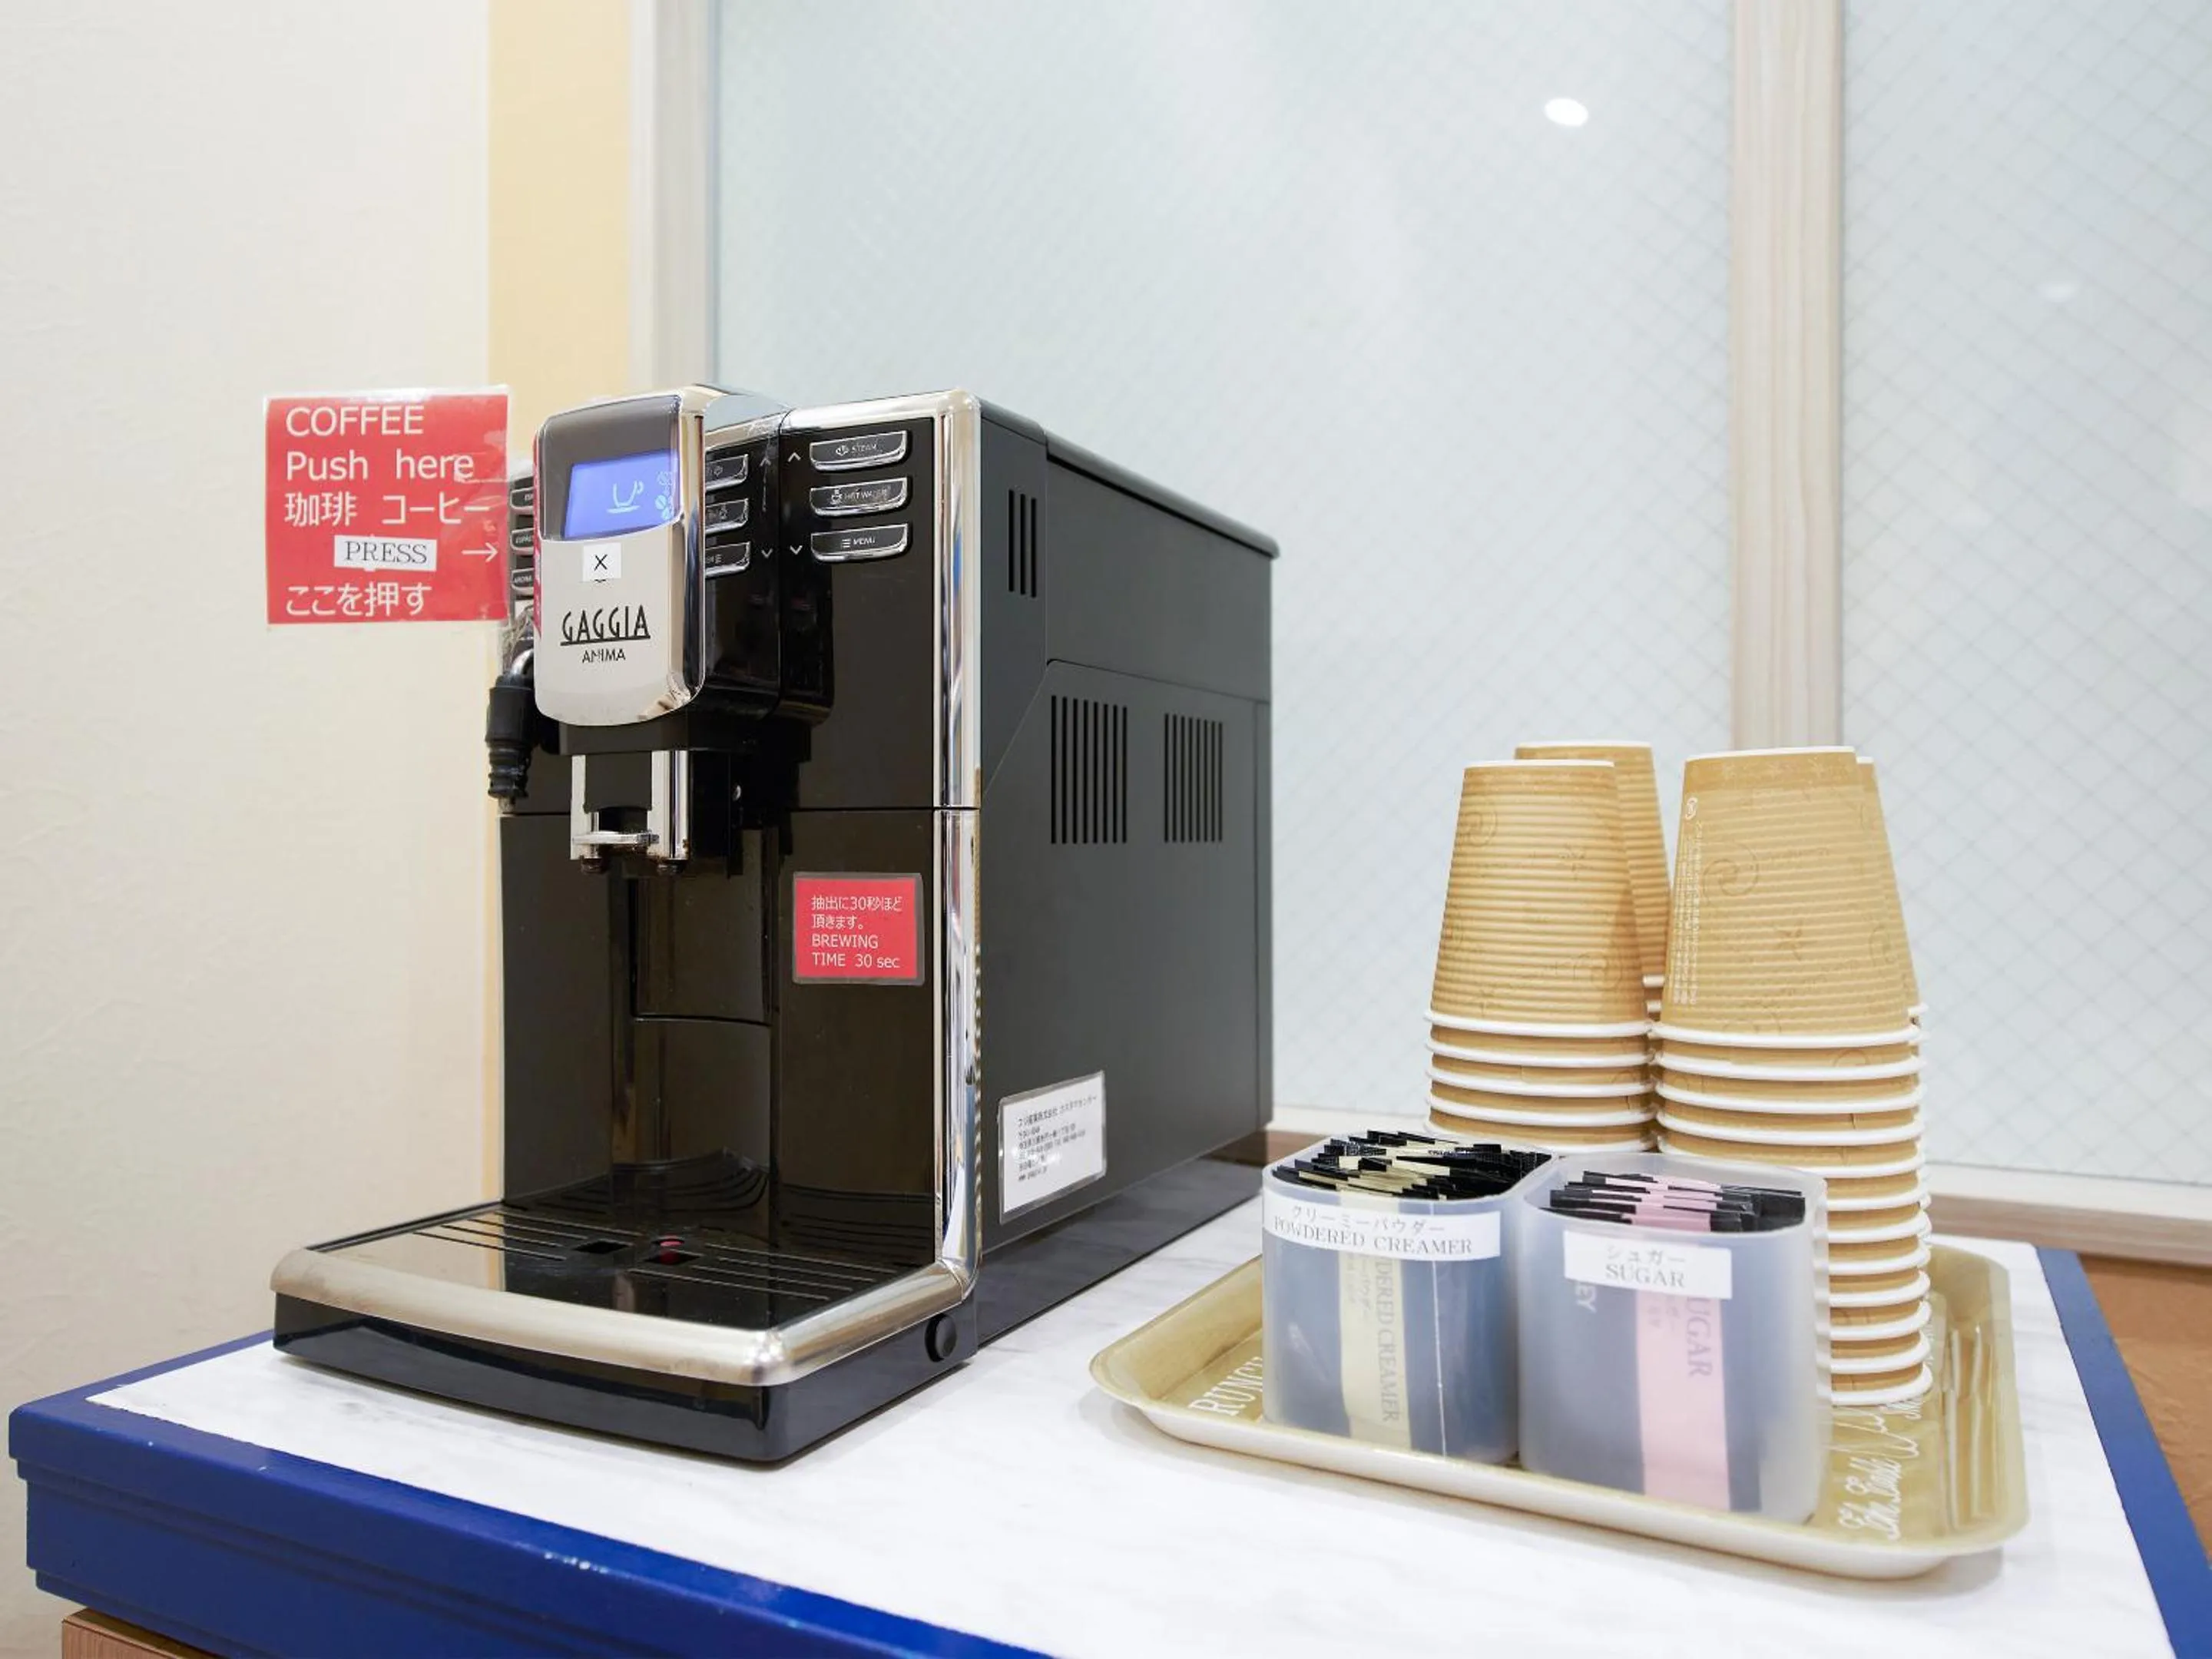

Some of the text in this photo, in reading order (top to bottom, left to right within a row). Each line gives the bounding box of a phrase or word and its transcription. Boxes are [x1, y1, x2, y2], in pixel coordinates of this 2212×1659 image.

[285, 404, 425, 437] COFFEE
[286, 448, 474, 482] Push here
[284, 492, 491, 528] 珈琲 コーヒー
[344, 540, 428, 565] PRESS
[285, 581, 432, 618] ここを押す
[561, 604, 651, 646] GAGGIA
[581, 647, 627, 664] ANIMA
[810, 932, 879, 949] BREWING
[811, 952, 901, 969] TIME 30 sec
[1273, 1215, 1472, 1255] POWDERED CREAMER
[1606, 1244, 1687, 1266] シュガー
[1605, 1263, 1687, 1289] SUGAR
[1575, 1283, 1598, 1313] EY
[1375, 1256, 1400, 1422] DERED CREAMER
[1687, 1296, 1714, 1376] UGAR
[1187, 1356, 1263, 1417] RUNC
